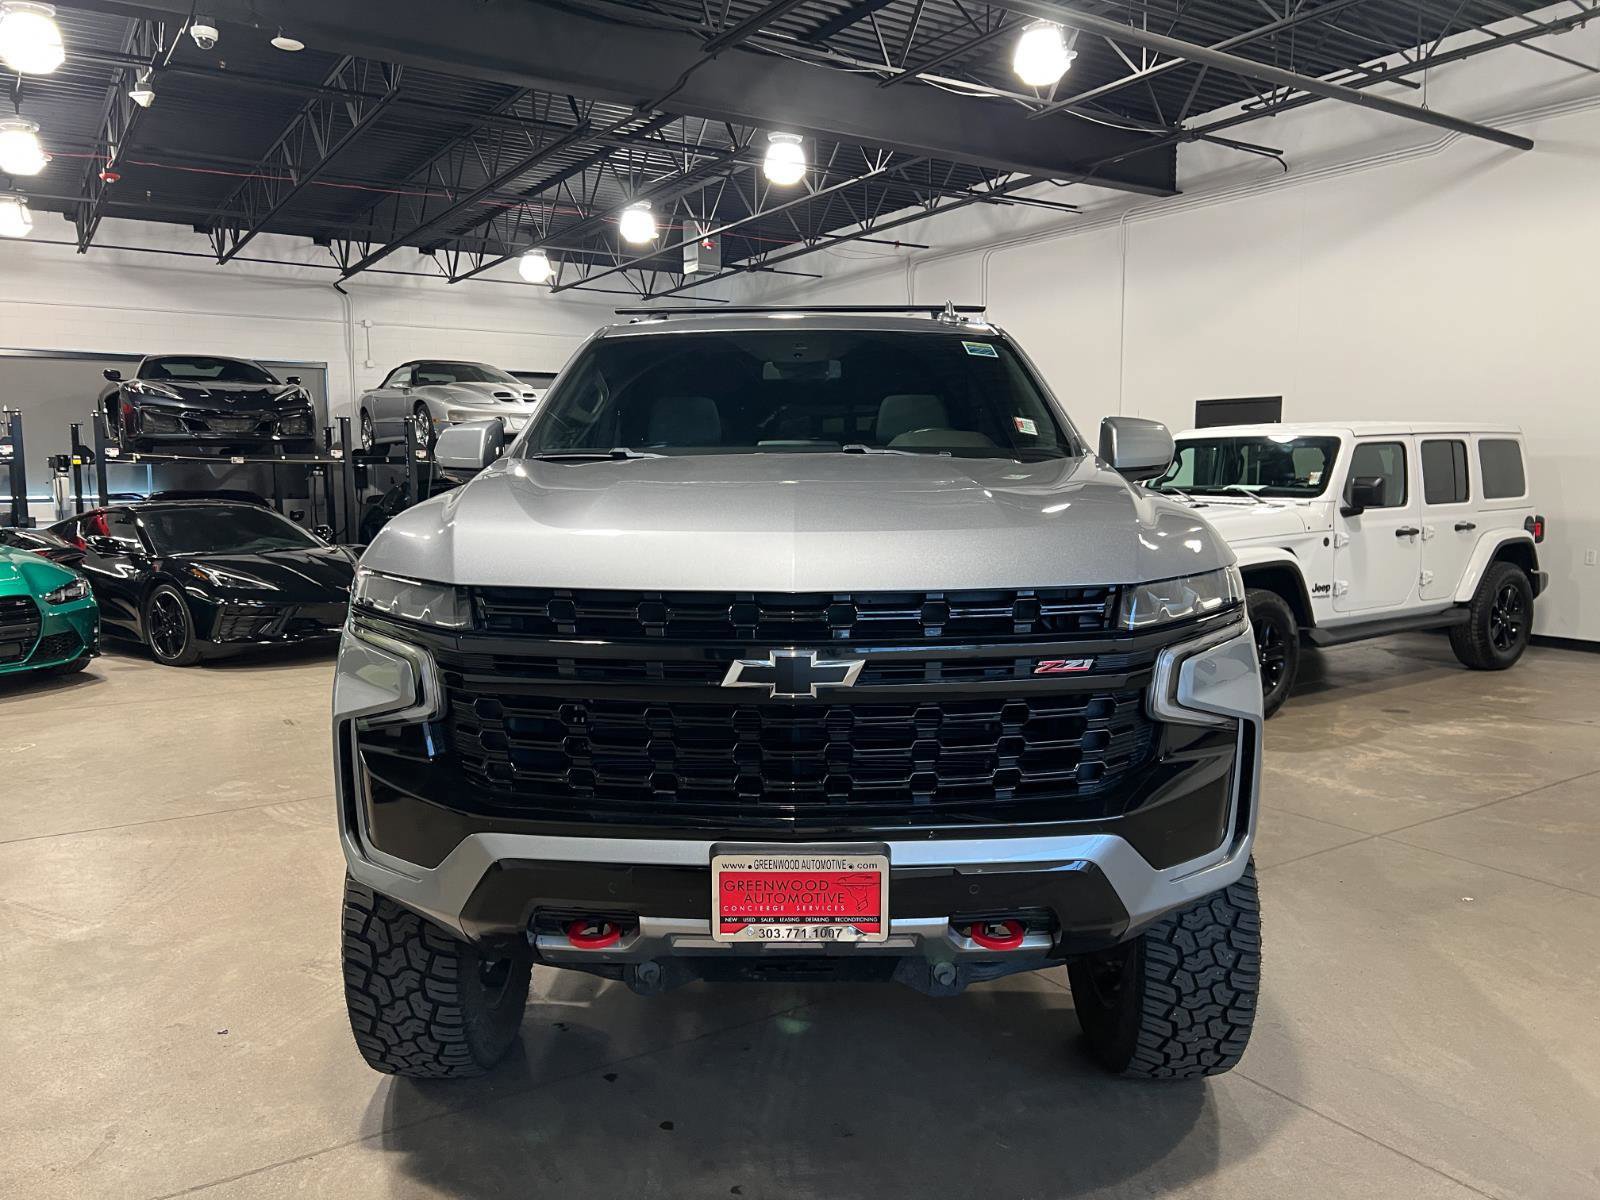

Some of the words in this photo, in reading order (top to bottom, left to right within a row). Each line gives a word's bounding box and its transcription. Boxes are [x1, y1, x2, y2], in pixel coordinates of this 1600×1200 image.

[1312, 583, 1330, 593] Jeep
[1034, 659, 1094, 674] Z71
[754, 859, 800, 870] GREENWOOD
[801, 859, 847, 870] AUTOMOTIVE
[724, 880, 829, 892] GREENWOOD
[744, 892, 845, 904] AUTOMOTIVE
[758, 928, 843, 939] 303.771.1007
